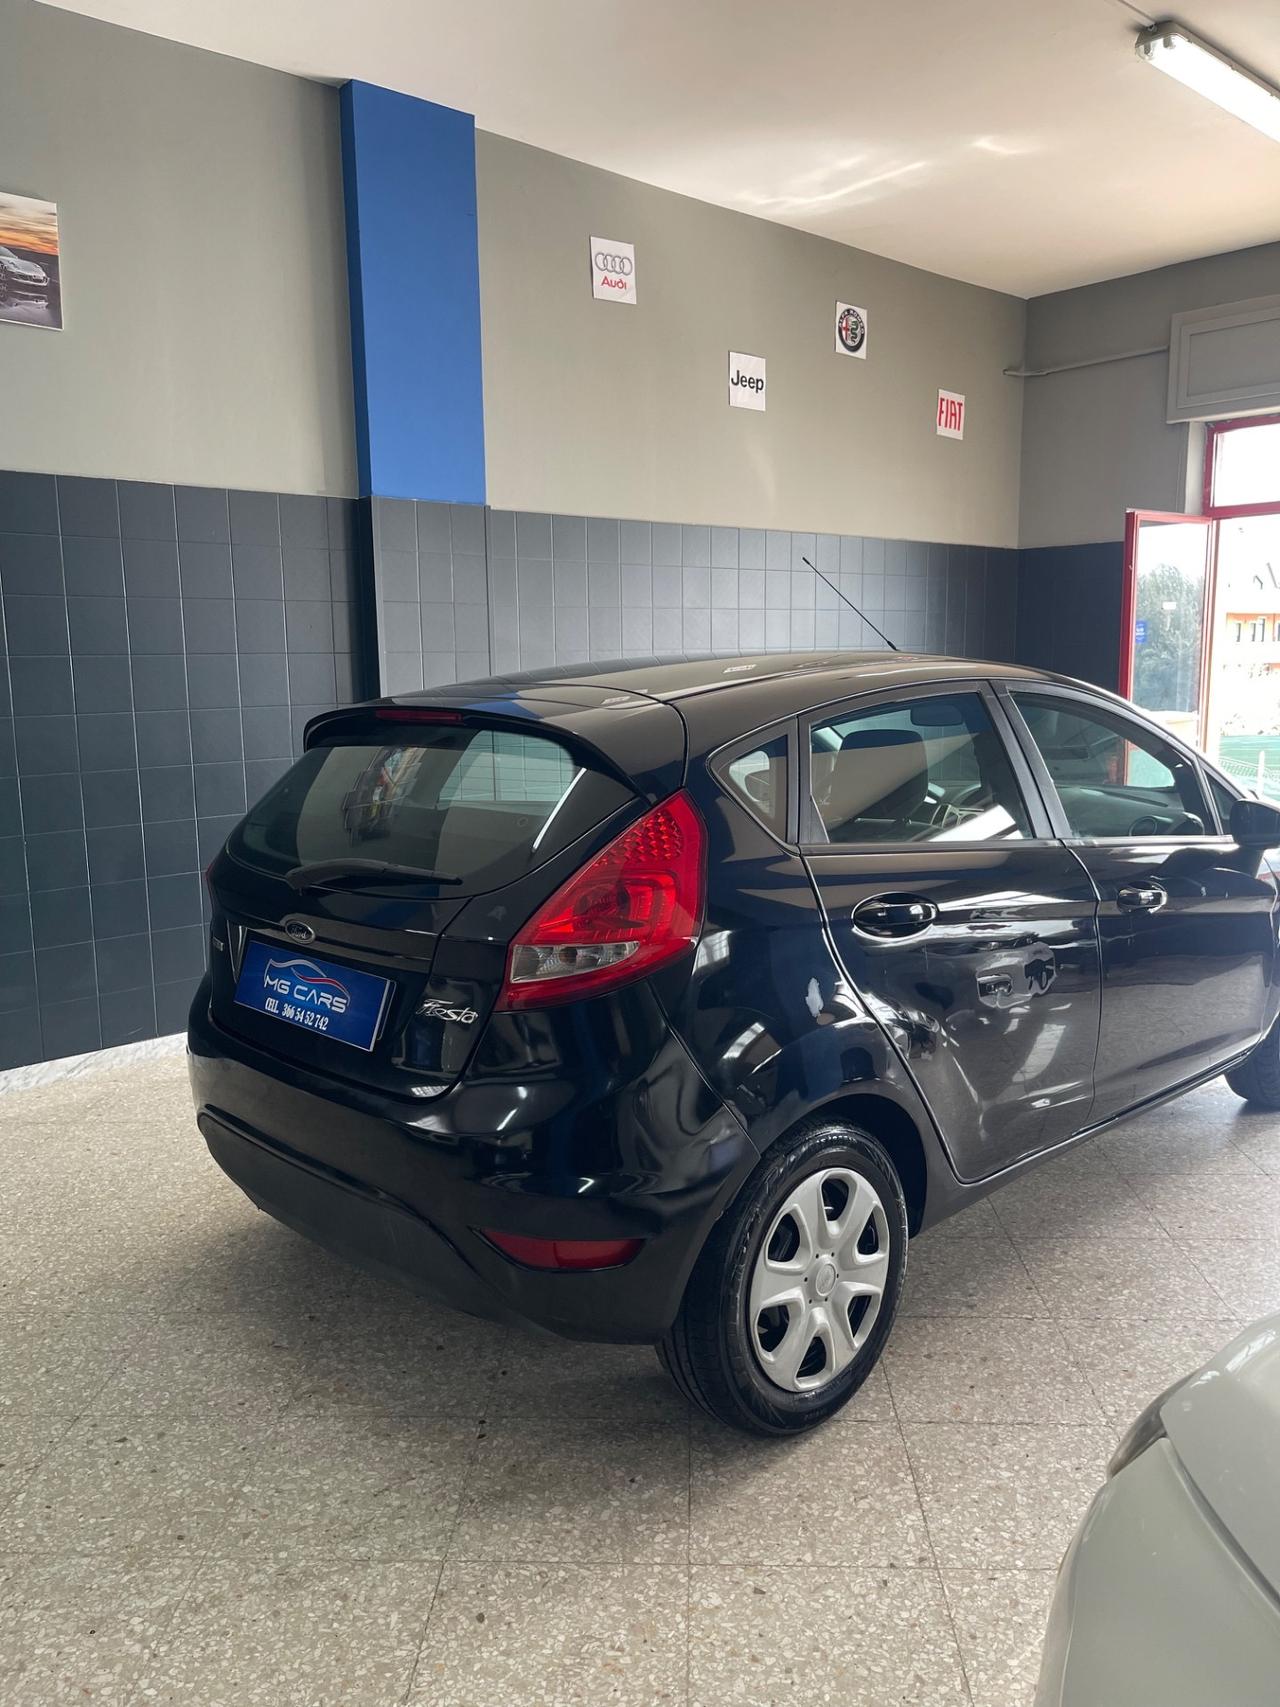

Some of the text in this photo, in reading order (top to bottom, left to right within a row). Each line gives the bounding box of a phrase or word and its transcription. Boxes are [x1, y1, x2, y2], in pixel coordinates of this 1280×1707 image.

[601, 275, 627, 290] Audi
[731, 369, 764, 394] Jeep
[938, 397, 963, 431] FIAT
[264, 975, 347, 1013] MG CARS
[305, 1011, 315, 1026] 52
[315, 1014, 329, 1031] 742
[416, 999, 479, 1024] Fiesta
